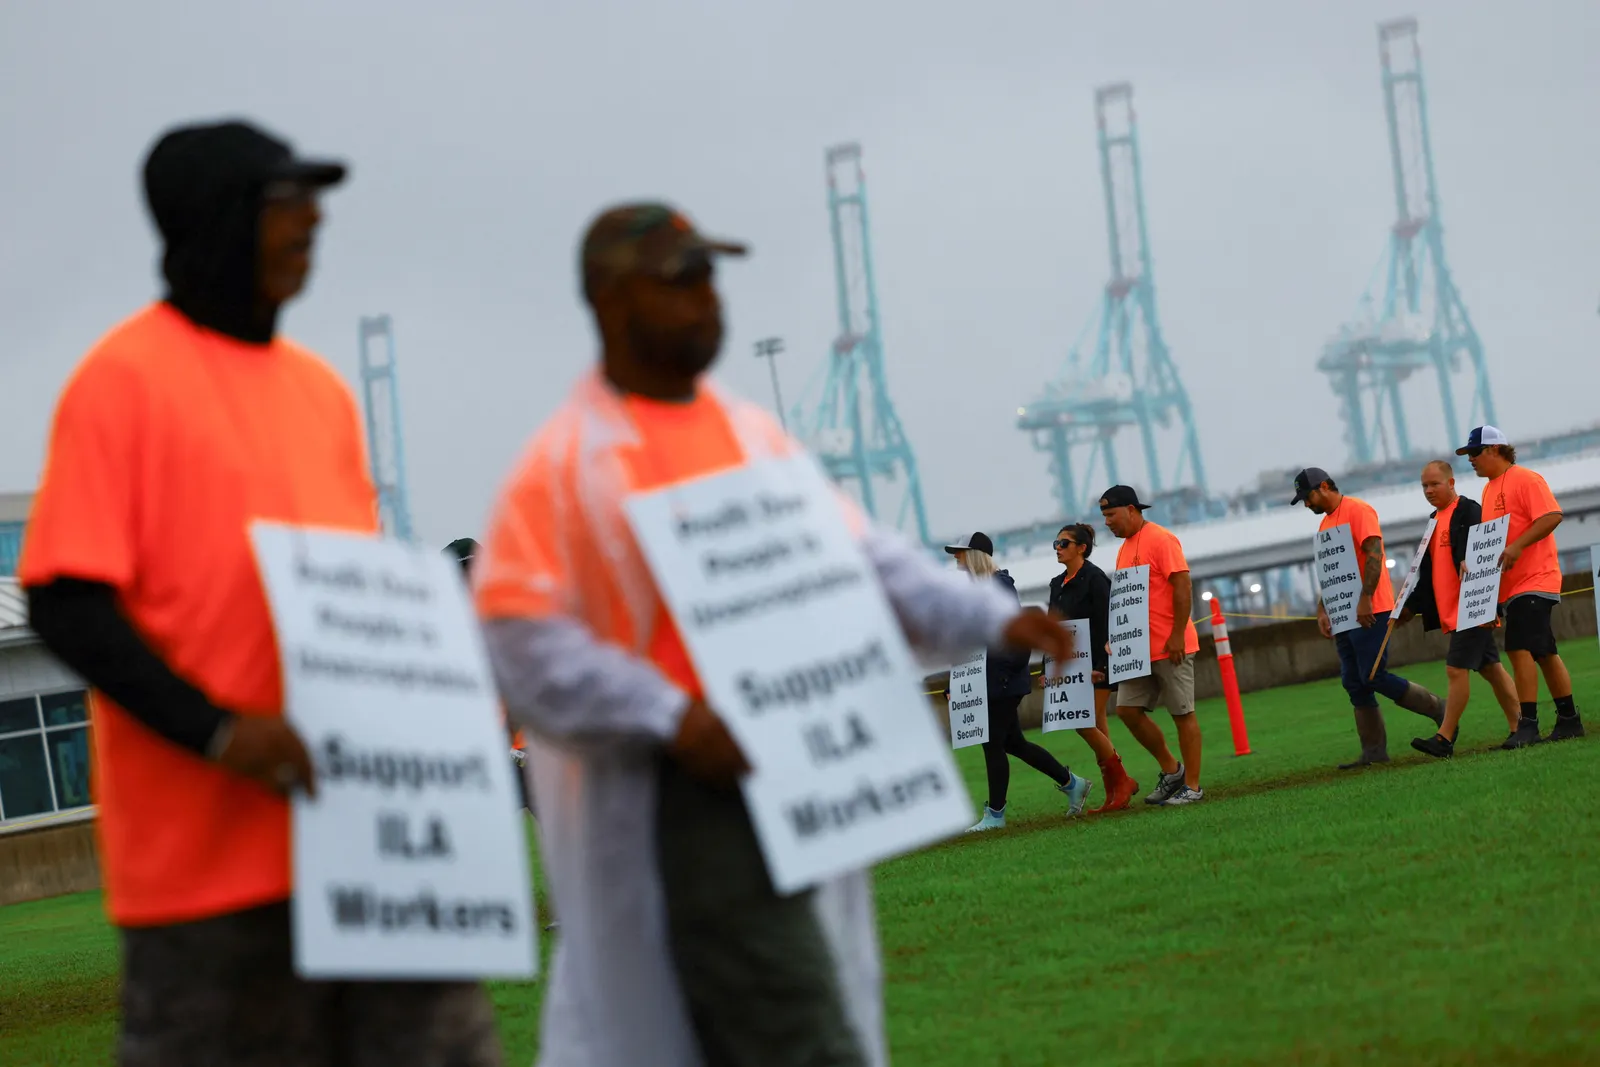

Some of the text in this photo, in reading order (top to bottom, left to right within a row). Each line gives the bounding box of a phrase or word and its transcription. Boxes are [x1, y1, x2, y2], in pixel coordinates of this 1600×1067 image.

[1483, 522, 1496, 535] ILA
[1321, 532, 1332, 544] ILA
[1472, 536, 1502, 551] Workers
[1318, 544, 1346, 560] Workers
[1476, 553, 1495, 564] Over
[1323, 561, 1339, 573] Over
[1114, 570, 1129, 583] ight
[1320, 572, 1357, 590] Machines:
[1340, 591, 1354, 599] Our
[1464, 584, 1495, 598] Defend Our
[1110, 596, 1143, 612] Save Jobs:
[1338, 601, 1352, 612] and
[1466, 596, 1491, 609] Jobs and
[1116, 614, 1129, 626] ILA
[1468, 608, 1486, 619] Rights
[1110, 628, 1143, 644] Demands
[1118, 645, 1132, 657] Job
[952, 666, 983, 680] Save Jobs:
[1112, 659, 1144, 675] Security
[736, 641, 890, 713] Support
[1044, 672, 1084, 688] Support
[960, 682, 973, 694] ILA
[951, 696, 983, 711] Demands
[1050, 691, 1069, 704] ILA
[962, 713, 975, 724] Job
[1044, 708, 1091, 724] Workers
[806, 712, 872, 766] ILA
[956, 727, 984, 740] Security
[323, 733, 491, 791] Support
[788, 767, 945, 836] Workers
[375, 815, 451, 858] ILA
[329, 884, 517, 934] Workers
